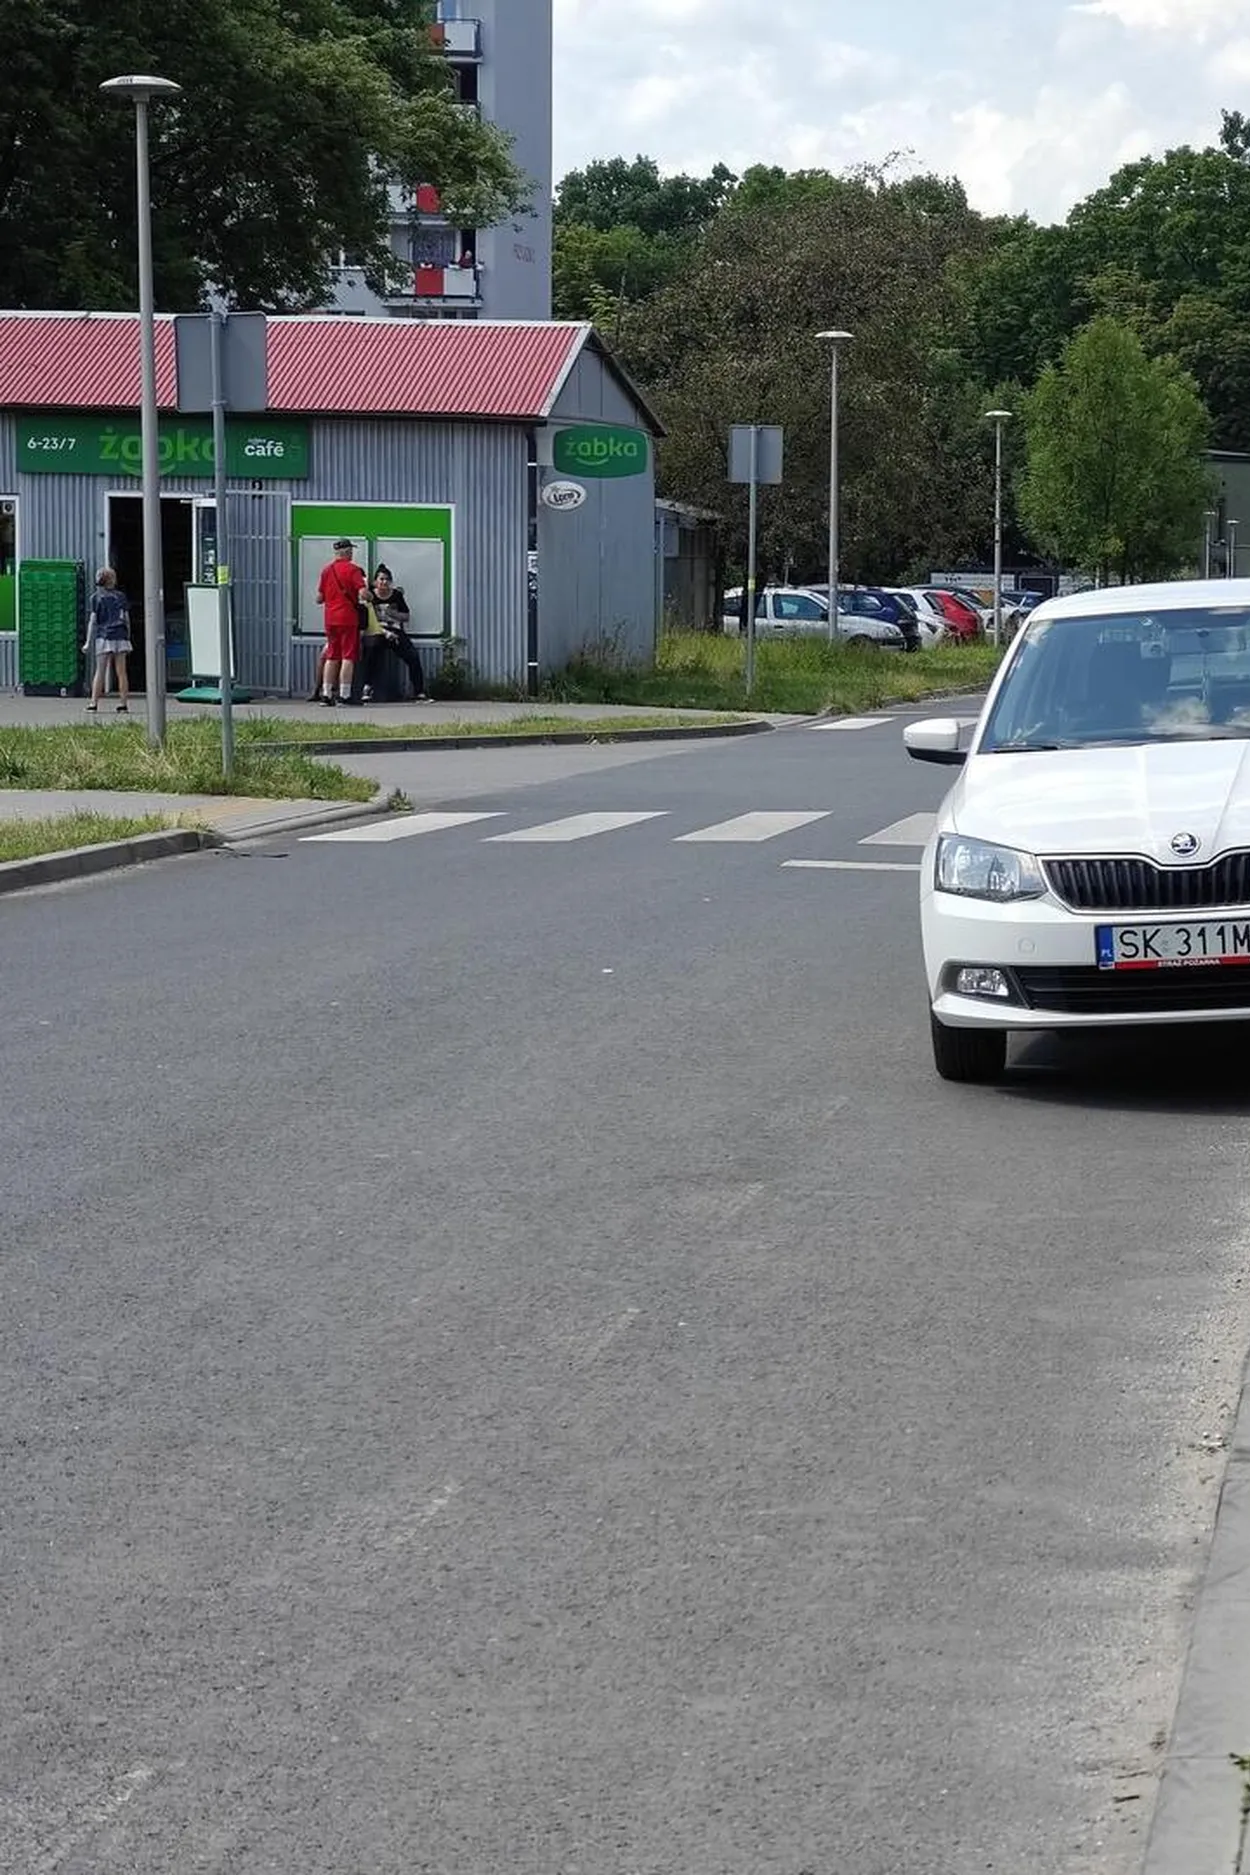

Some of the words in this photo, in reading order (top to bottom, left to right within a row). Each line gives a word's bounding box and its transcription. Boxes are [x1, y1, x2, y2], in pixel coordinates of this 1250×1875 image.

[27, 436, 76, 450] 6-23/7
[565, 437, 638, 457] żabka
[1119, 929, 1162, 958] SK
[1157, 959, 1182, 967] STRAŻ
[1183, 958, 1220, 966] POŻARNA
